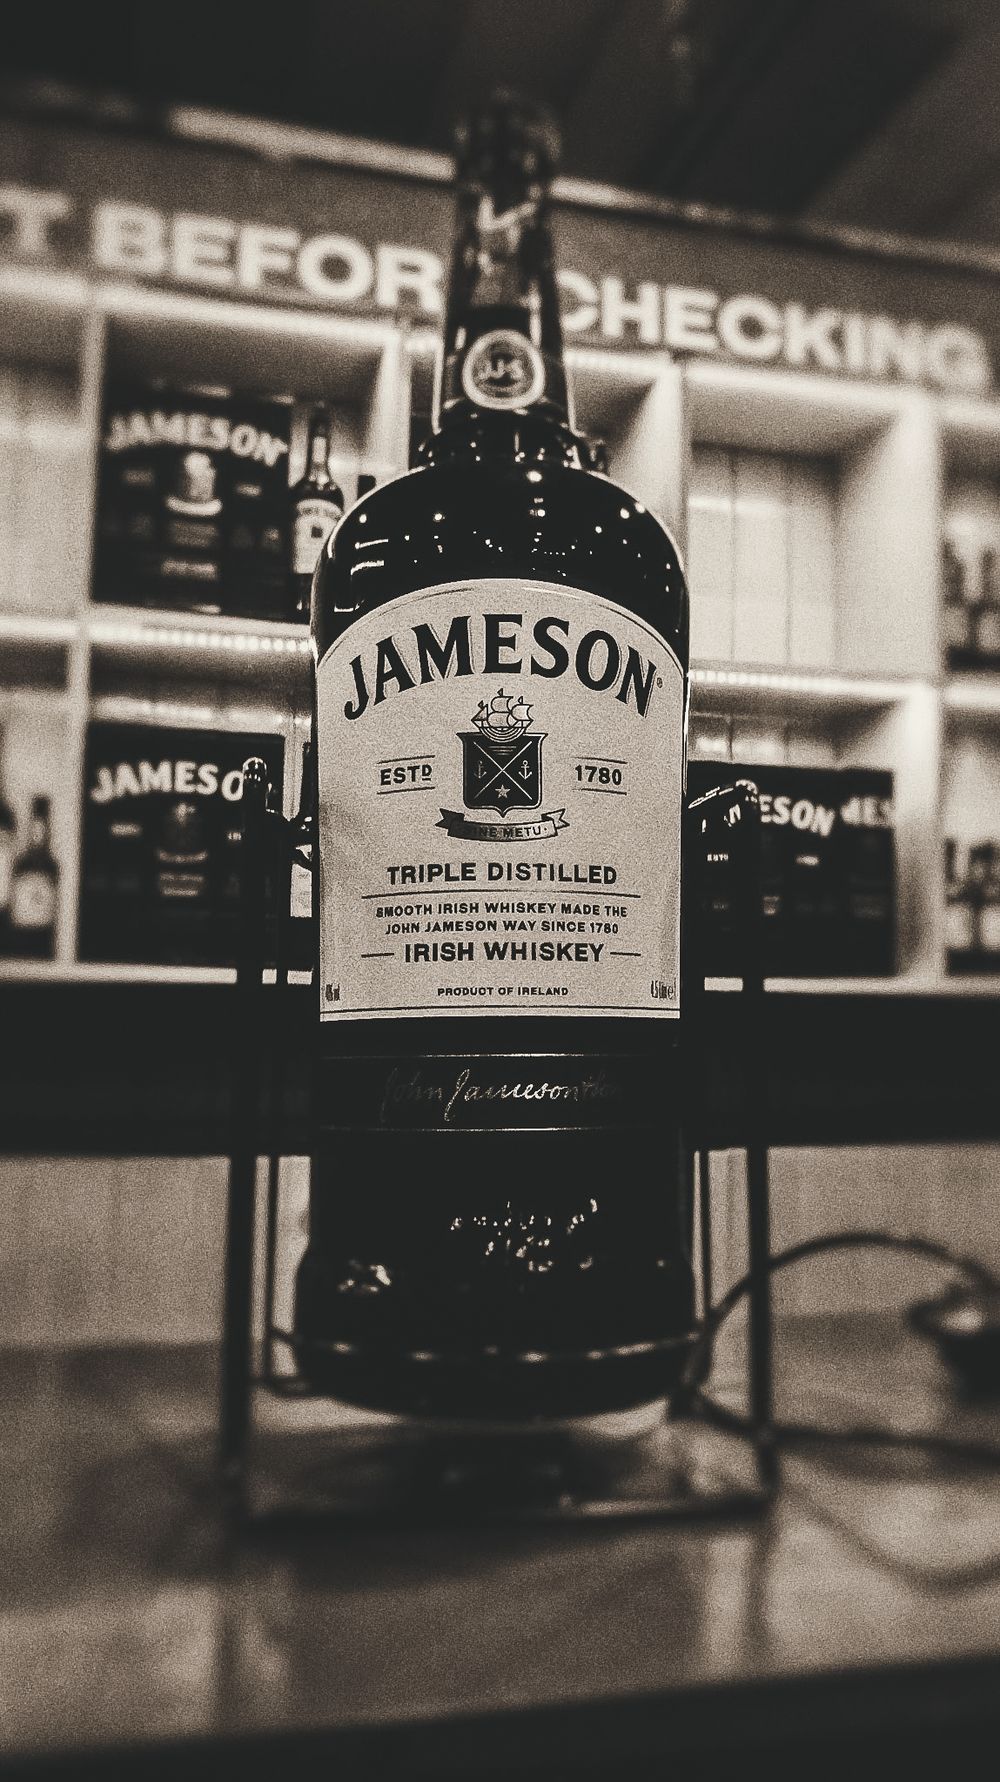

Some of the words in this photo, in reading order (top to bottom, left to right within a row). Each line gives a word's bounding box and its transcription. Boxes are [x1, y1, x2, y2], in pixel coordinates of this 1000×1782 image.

[96, 199, 444, 312] BEFOR
[106, 410, 288, 466] JAMESON
[344, 613, 657, 720] JAMESON
[91, 760, 244, 803] JAMESO
[380, 763, 433, 785] ESTD
[575, 764, 623, 786] 1780
[503, 826, 541, 839] METU
[387, 863, 477, 885] TRIPLE
[487, 862, 618, 885] DISTILLED
[375, 904, 433, 918] SMOOTH
[437, 902, 479, 915] IRISH
[485, 902, 557, 914] WHISKEY
[561, 903, 600, 916] MADE
[604, 905, 628, 918] THE
[385, 922, 420, 935] JOHN
[424, 920, 498, 933] JAMESON
[502, 920, 536, 931] WAY
[540, 920, 586, 933] SINCE
[589, 922, 619, 934] 1780
[405, 942, 475, 963] IRISH
[483, 941, 604, 963] WHISKEY
[437, 986, 494, 997] PRODUCT
[497, 986, 514, 996] OF
[517, 986, 569, 996] IRELAND
[443, 1067, 579, 1122] Jameson
